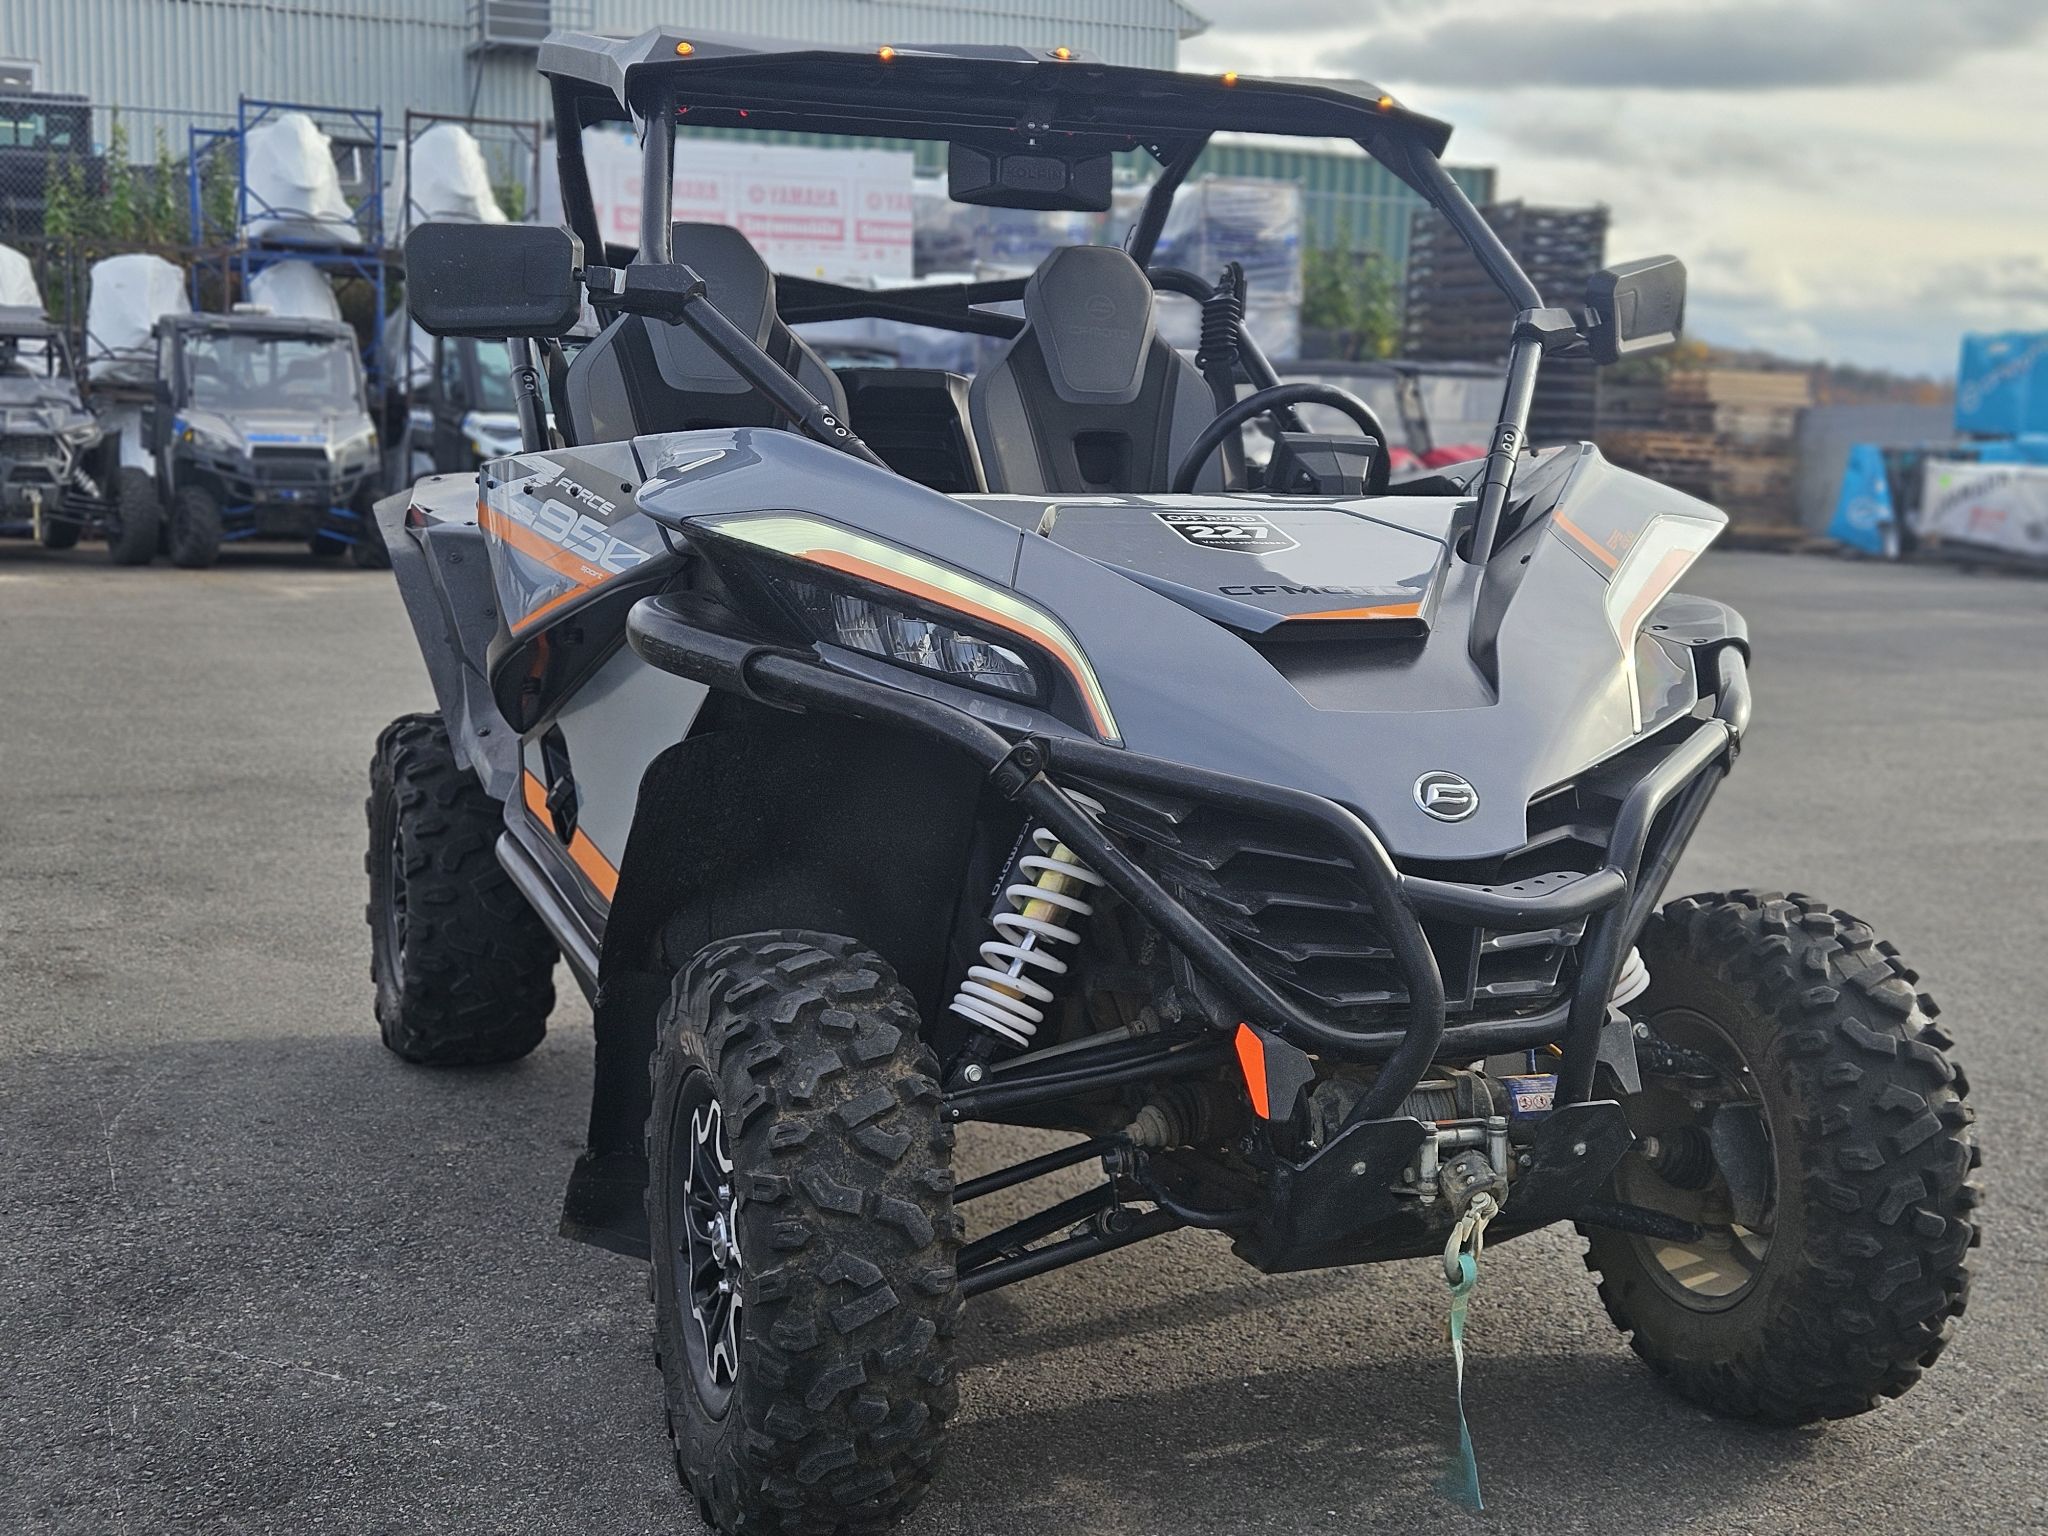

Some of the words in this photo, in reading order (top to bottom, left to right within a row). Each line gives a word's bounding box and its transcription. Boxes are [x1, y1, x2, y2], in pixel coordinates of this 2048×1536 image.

[531, 498, 652, 575] 950
[1185, 525, 1269, 539] 227
[580, 565, 604, 580] sport
